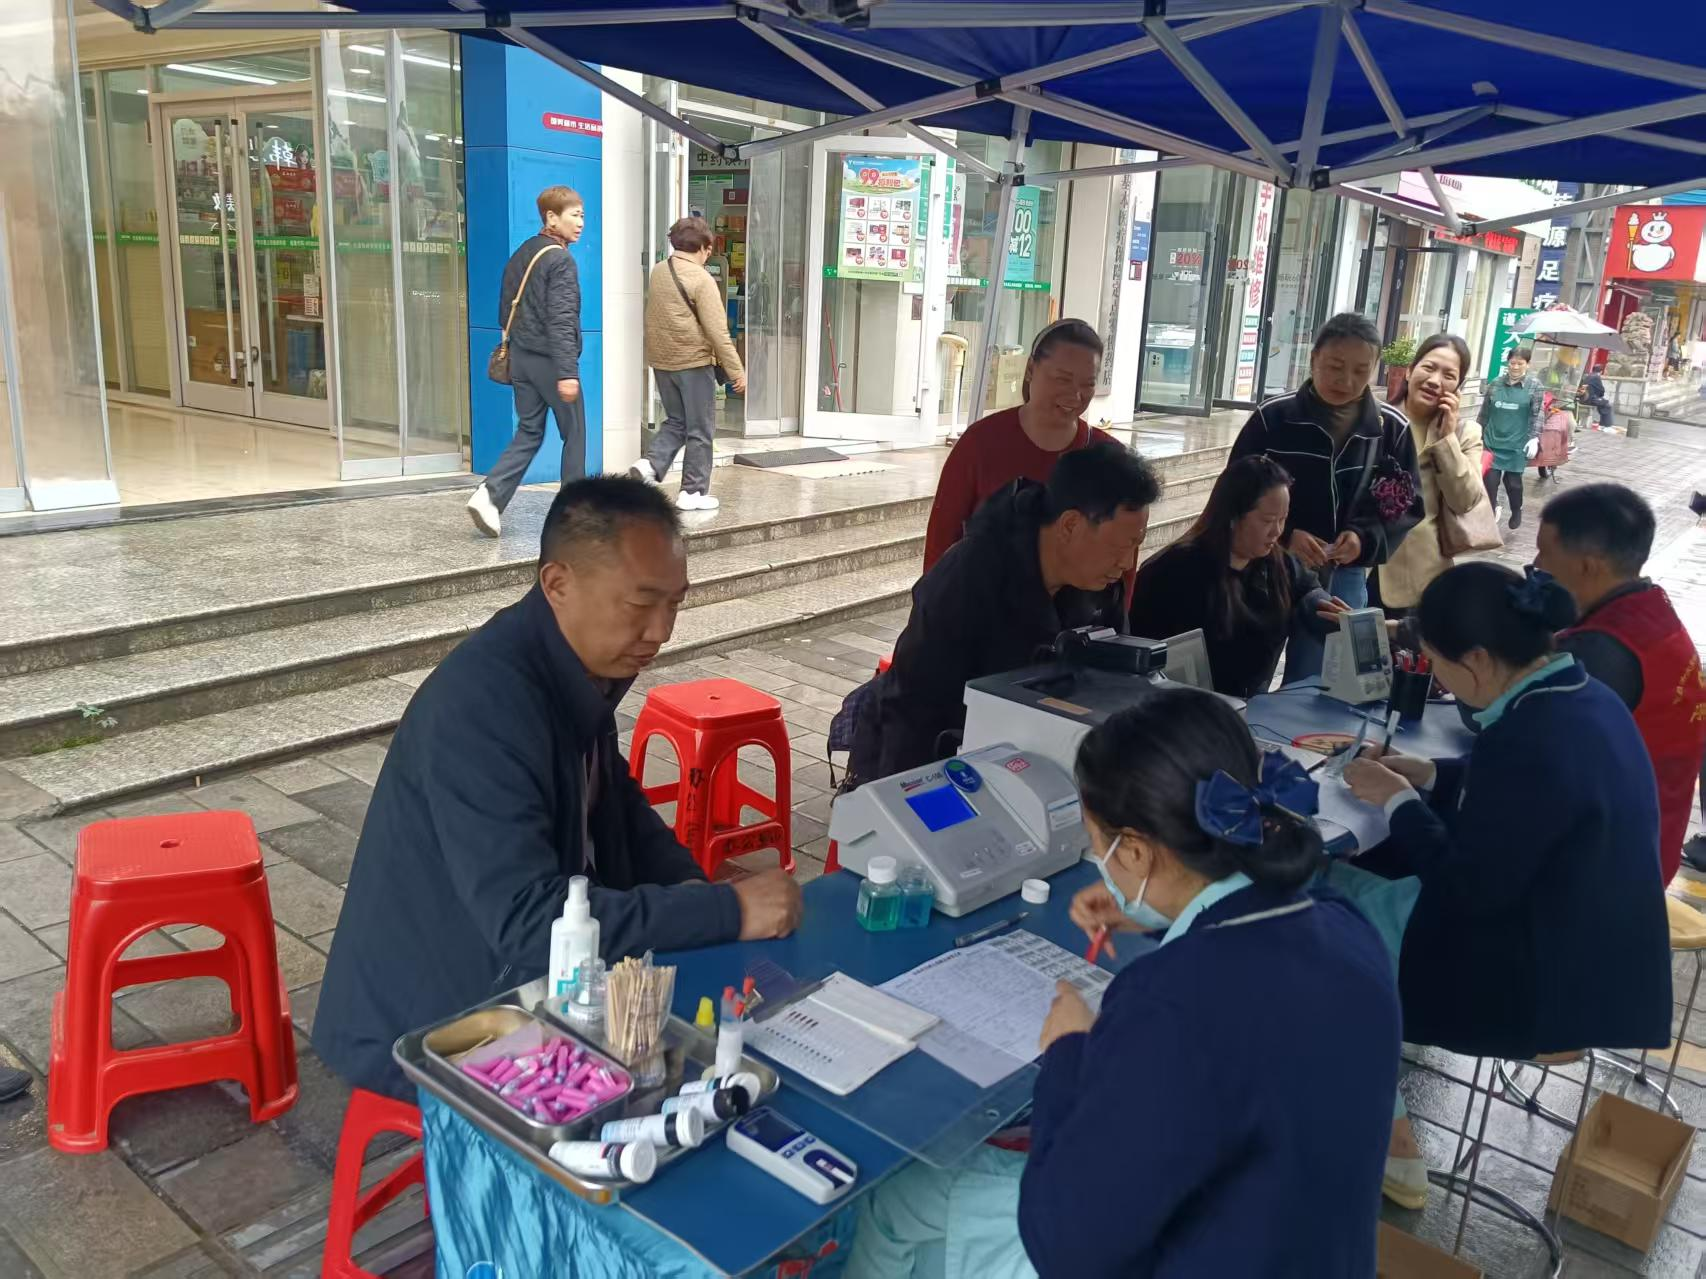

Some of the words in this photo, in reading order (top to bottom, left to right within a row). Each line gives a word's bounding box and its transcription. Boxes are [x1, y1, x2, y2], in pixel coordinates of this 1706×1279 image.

[1176, 253, 1202, 265] 20%
[1248, 183, 1273, 308] 手机维修
